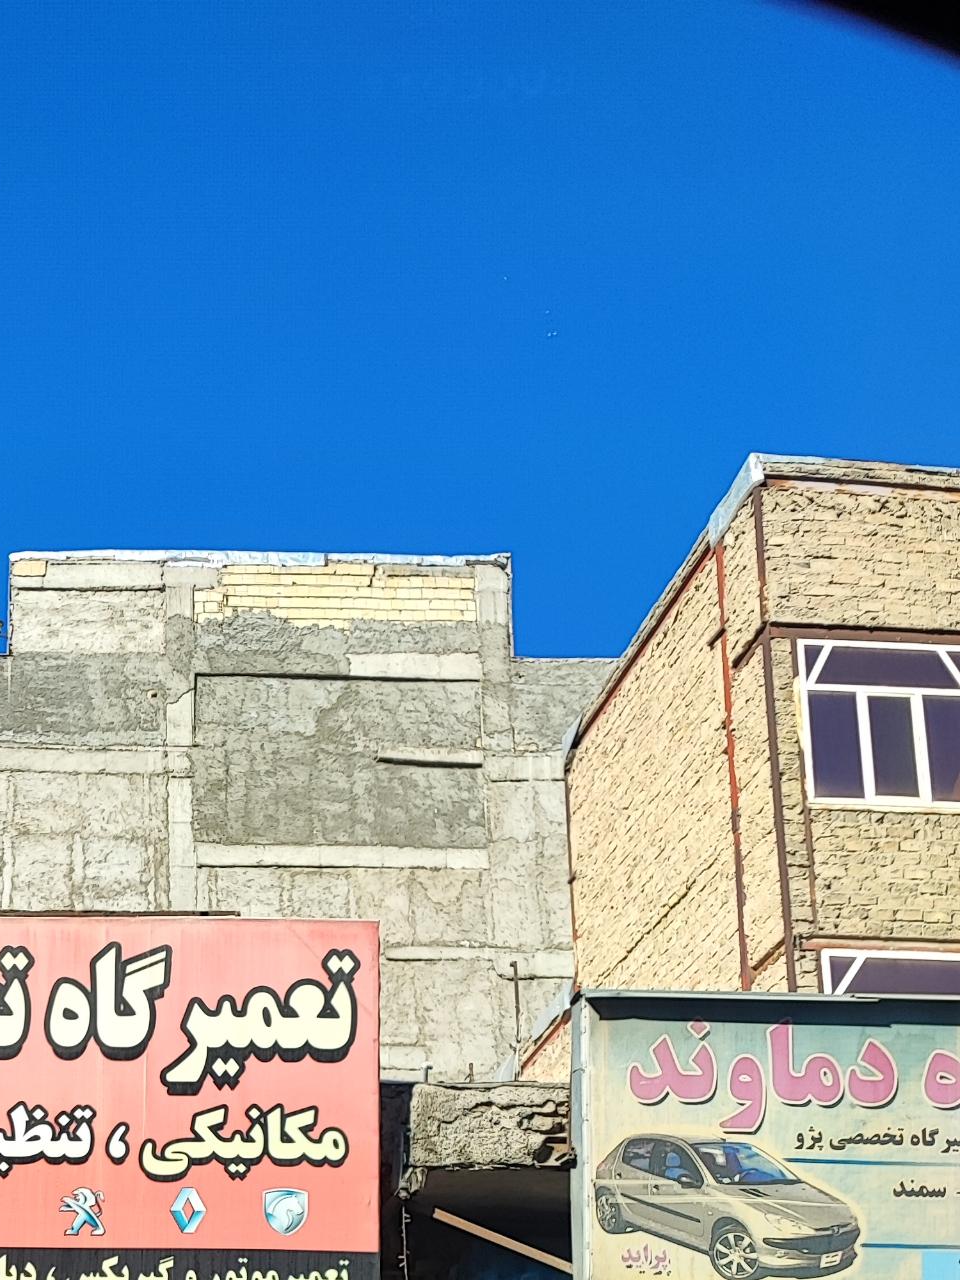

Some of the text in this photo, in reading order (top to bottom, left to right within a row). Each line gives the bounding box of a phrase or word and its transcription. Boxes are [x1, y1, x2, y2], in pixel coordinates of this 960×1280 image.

[628, 1017, 898, 1133] دماوند
[795, 1126, 823, 1151] پژو
[830, 1127, 904, 1150] تخصصی
[893, 1179, 946, 1198] سمند
